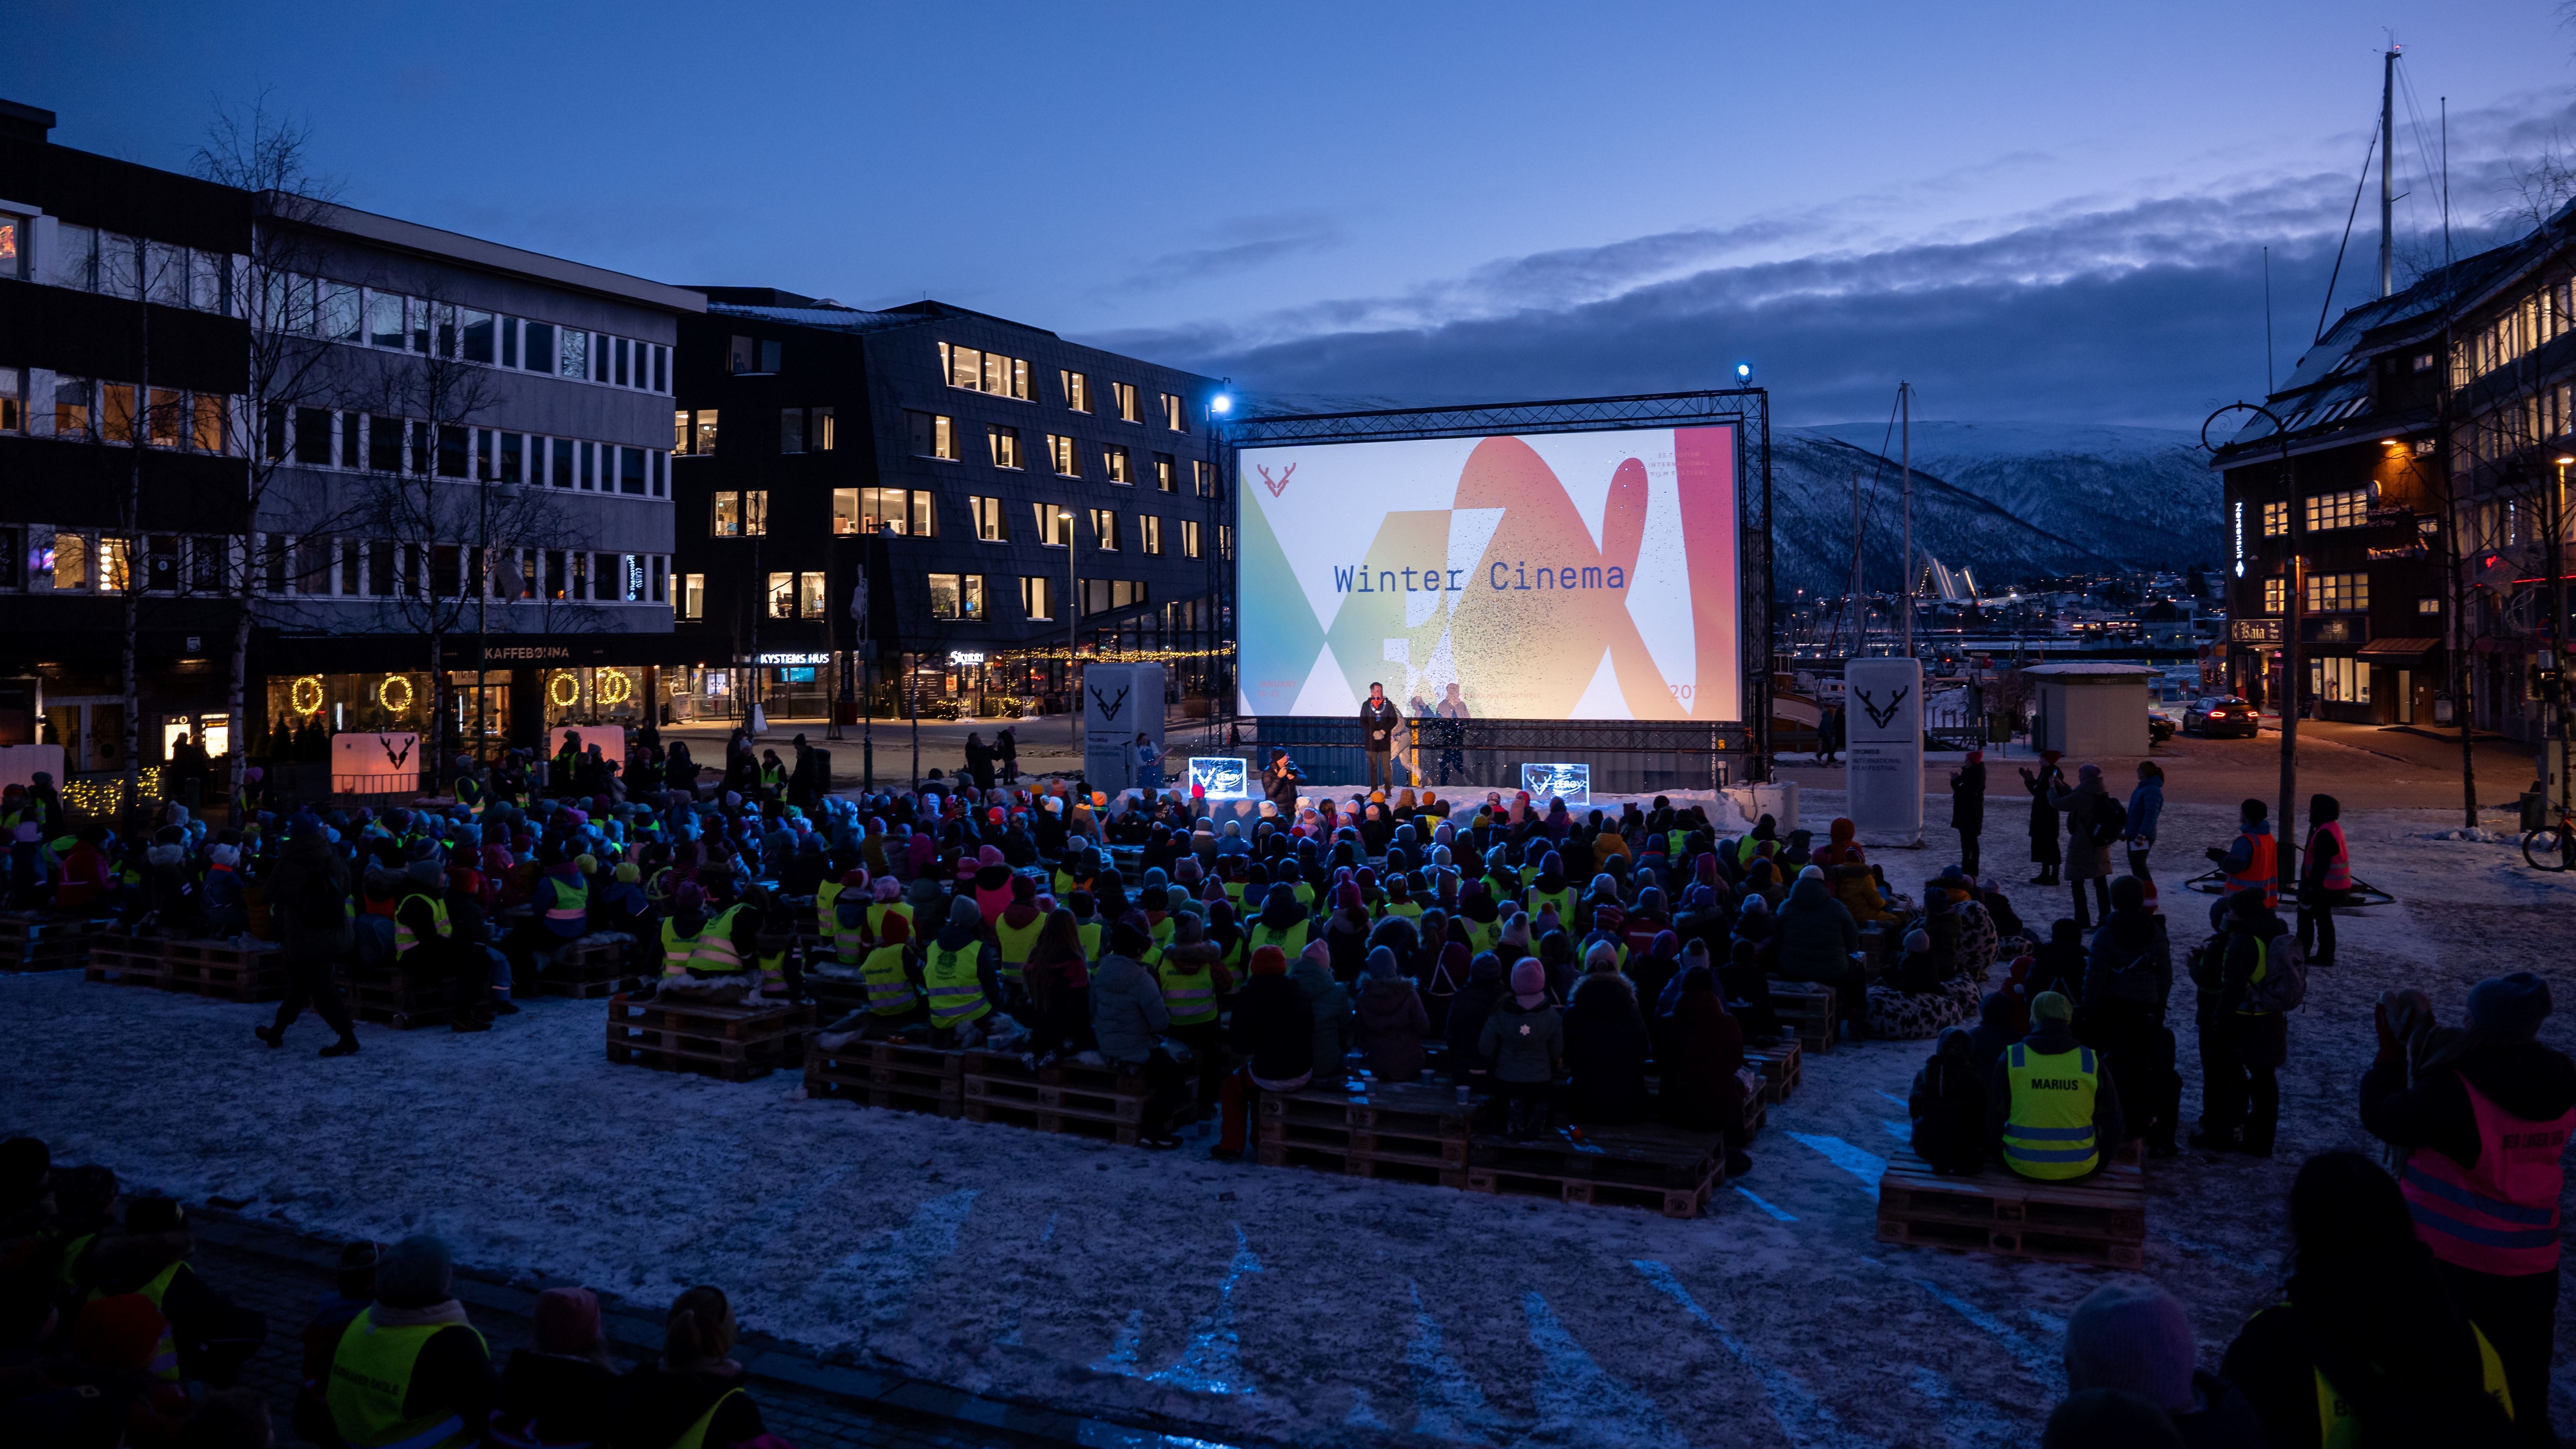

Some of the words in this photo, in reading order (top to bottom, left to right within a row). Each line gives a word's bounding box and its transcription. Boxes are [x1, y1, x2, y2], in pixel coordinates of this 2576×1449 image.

[1334, 564, 1463, 593] Winter
[1490, 561, 1624, 590] Cinema
[484, 646, 570, 659] KAFFEBØNNA
[761, 654, 806, 664] KYSTENS
[808, 653, 830, 663] HUS
[1216, 773, 1241, 781] LERØY
[2031, 1079, 2078, 1090] MARIUS
[370, 1377, 399, 1396] SKOLE
